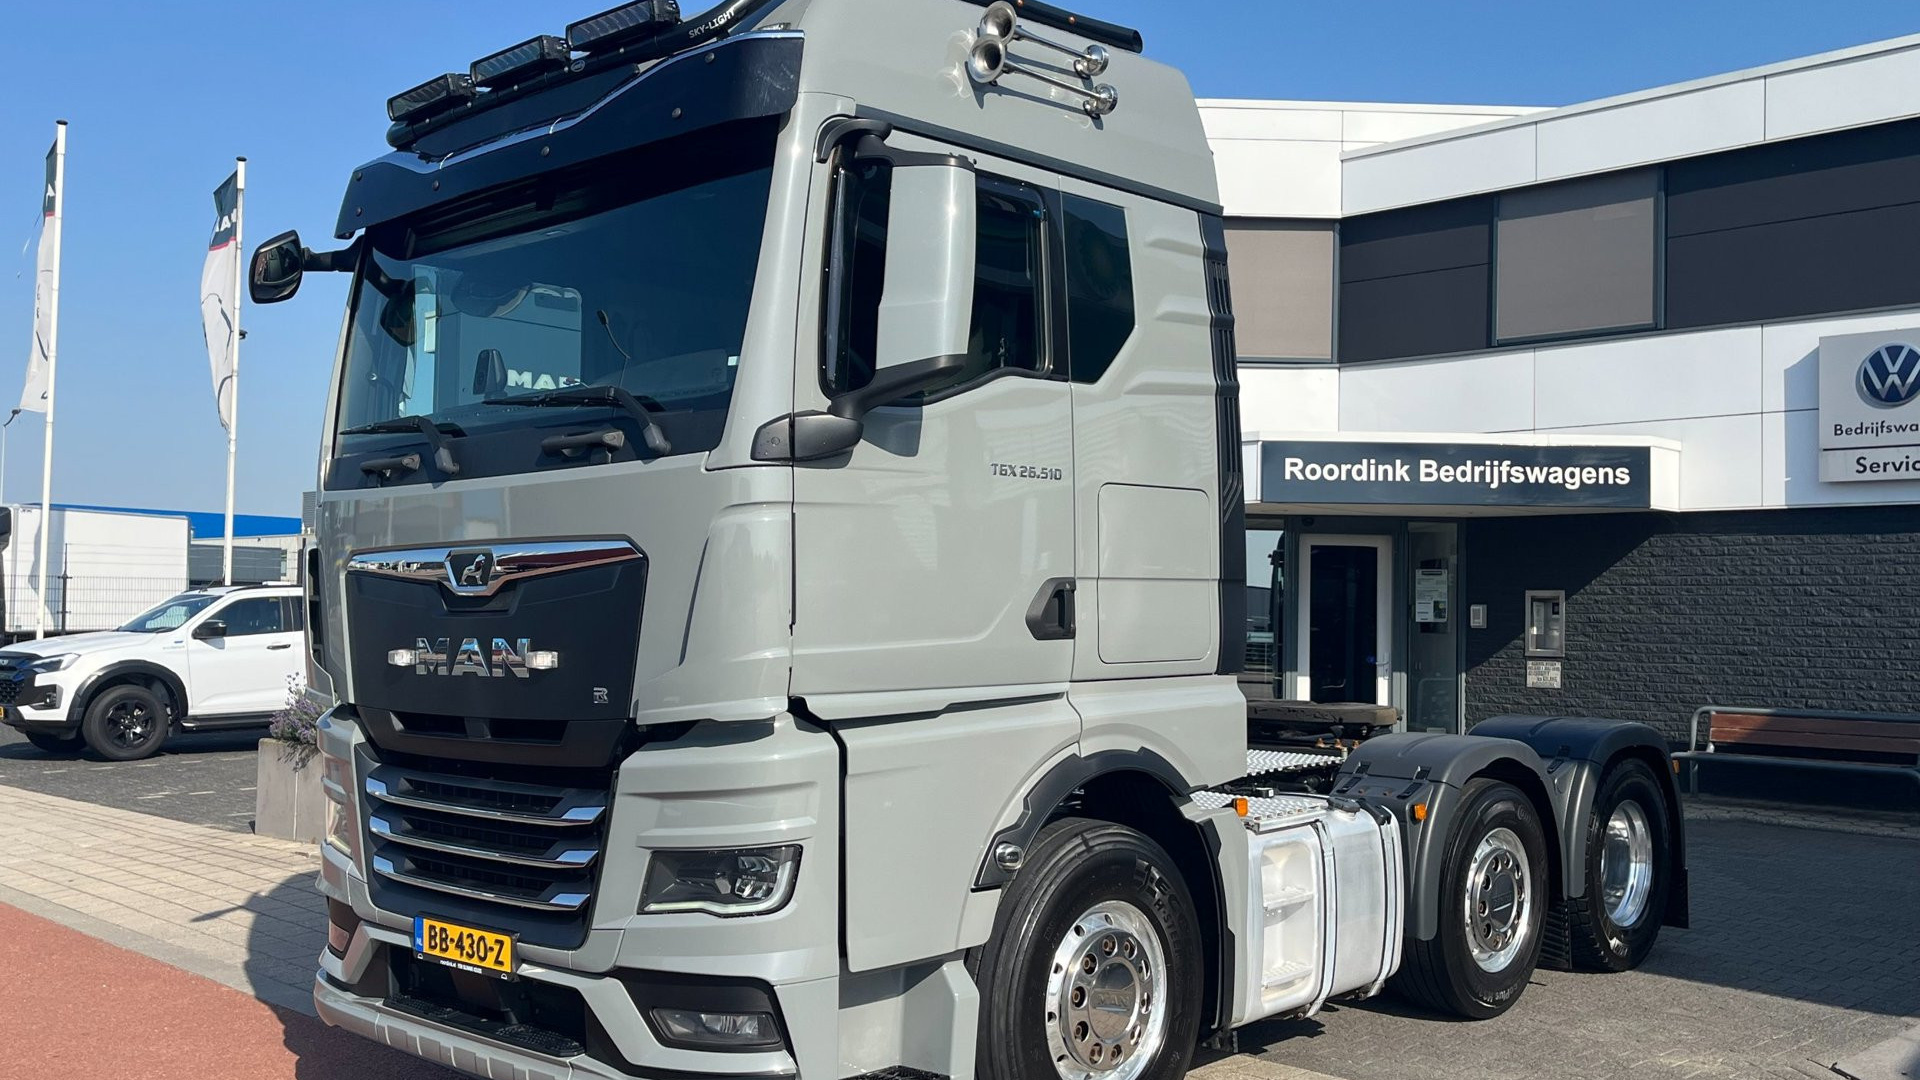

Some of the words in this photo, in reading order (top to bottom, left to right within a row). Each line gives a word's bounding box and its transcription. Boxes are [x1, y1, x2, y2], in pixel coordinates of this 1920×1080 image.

[688, 6, 735, 38] SKY-LIGHT
[991, 463, 1017, 477] TGX
[1019, 465, 1062, 481] 26.510
[1284, 457, 1411, 482] Roordink
[1419, 459, 1631, 489] Bedrijfswagens
[415, 637, 531, 678] MAN
[428, 924, 505, 967] BB-430-Z
